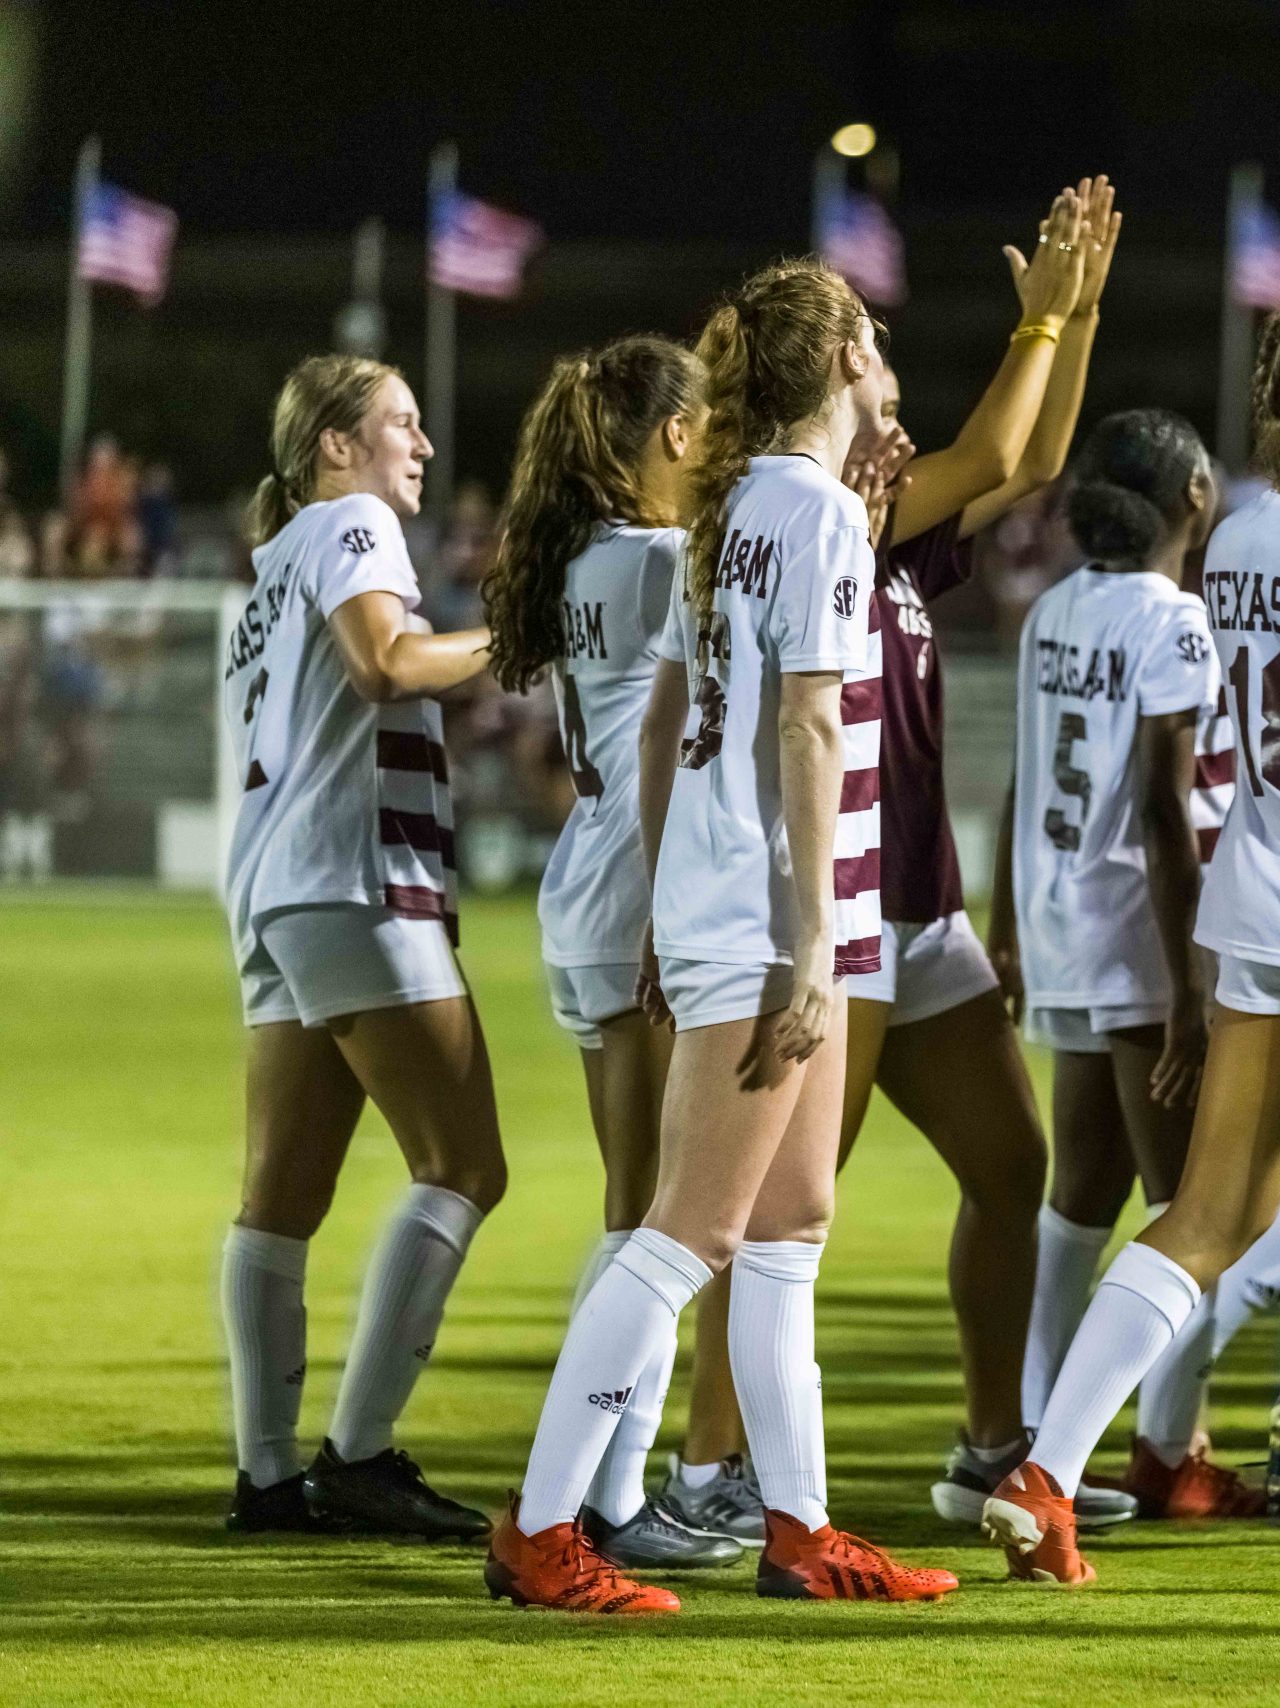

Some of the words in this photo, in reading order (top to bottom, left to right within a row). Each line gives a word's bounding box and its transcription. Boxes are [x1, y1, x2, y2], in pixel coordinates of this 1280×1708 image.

[341, 527, 377, 554] SEC
[715, 529, 774, 599] A&M
[1044, 711, 1092, 853] 5
